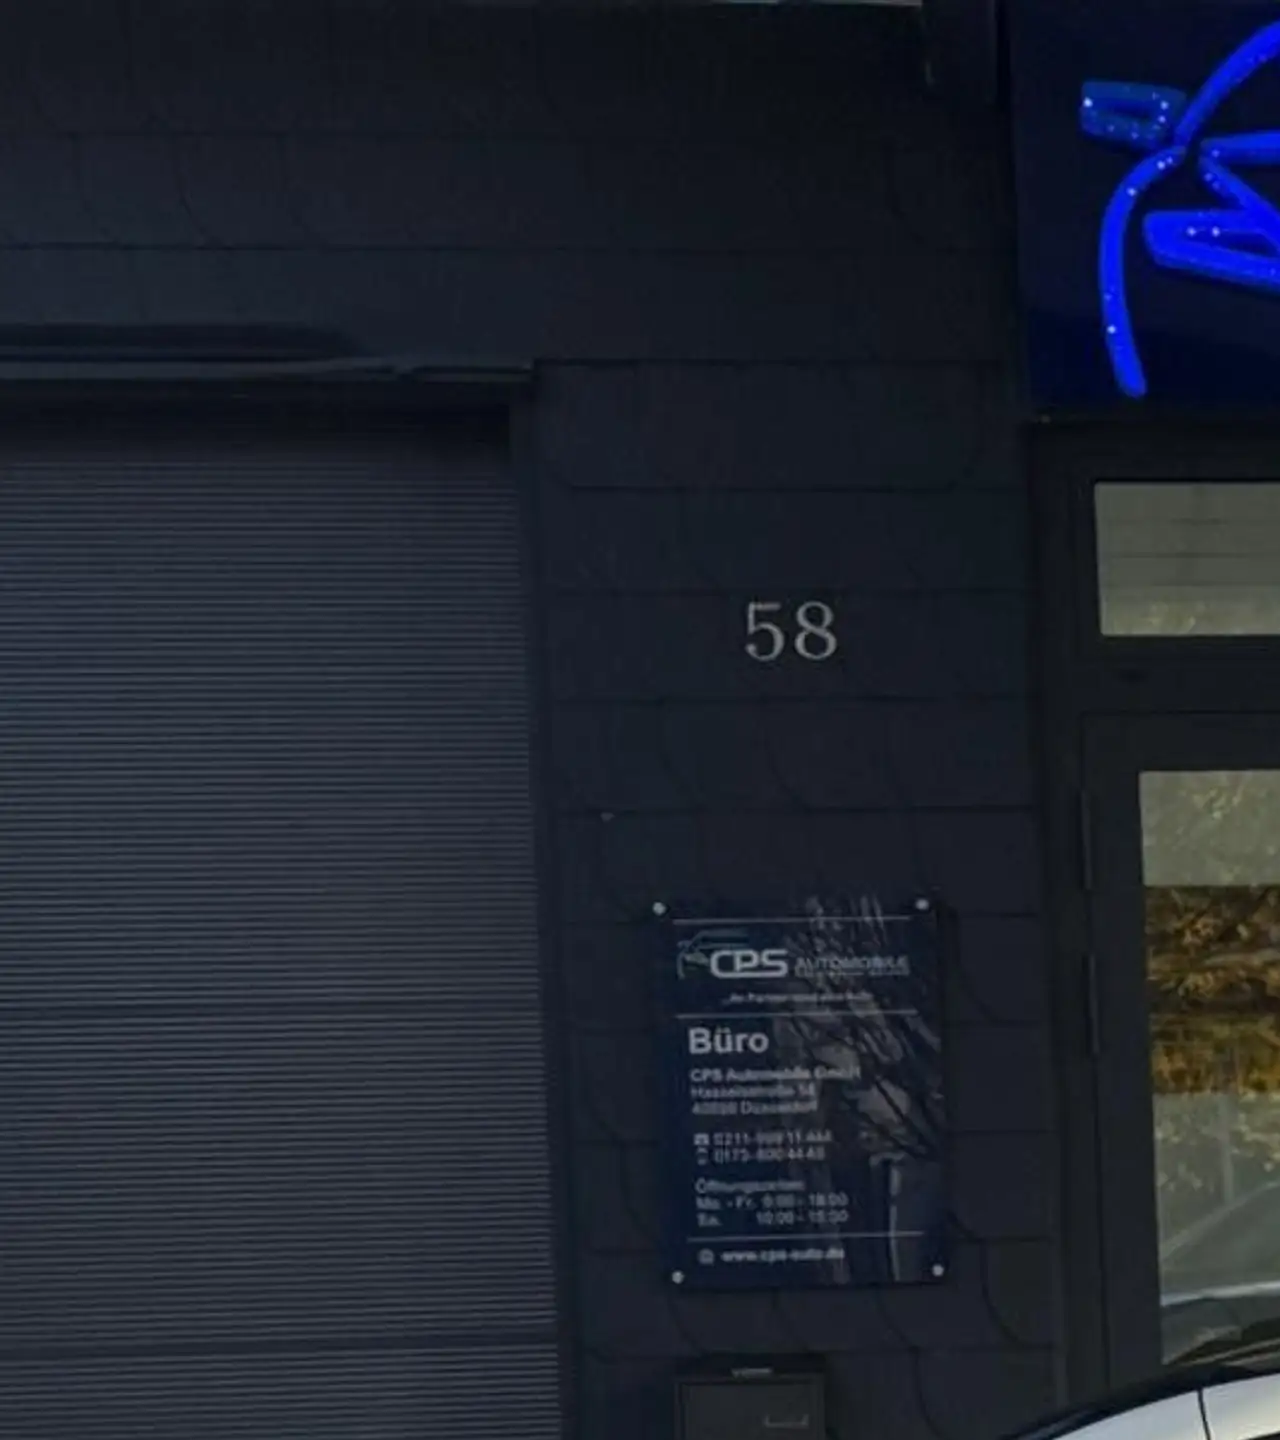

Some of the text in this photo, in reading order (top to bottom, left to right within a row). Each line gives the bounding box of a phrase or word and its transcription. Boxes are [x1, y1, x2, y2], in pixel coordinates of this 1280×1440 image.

[745, 601, 837, 661] 58
[710, 948, 788, 979] CPS
[688, 1027, 769, 1055] Büro
[690, 1067, 723, 1082] CPS
